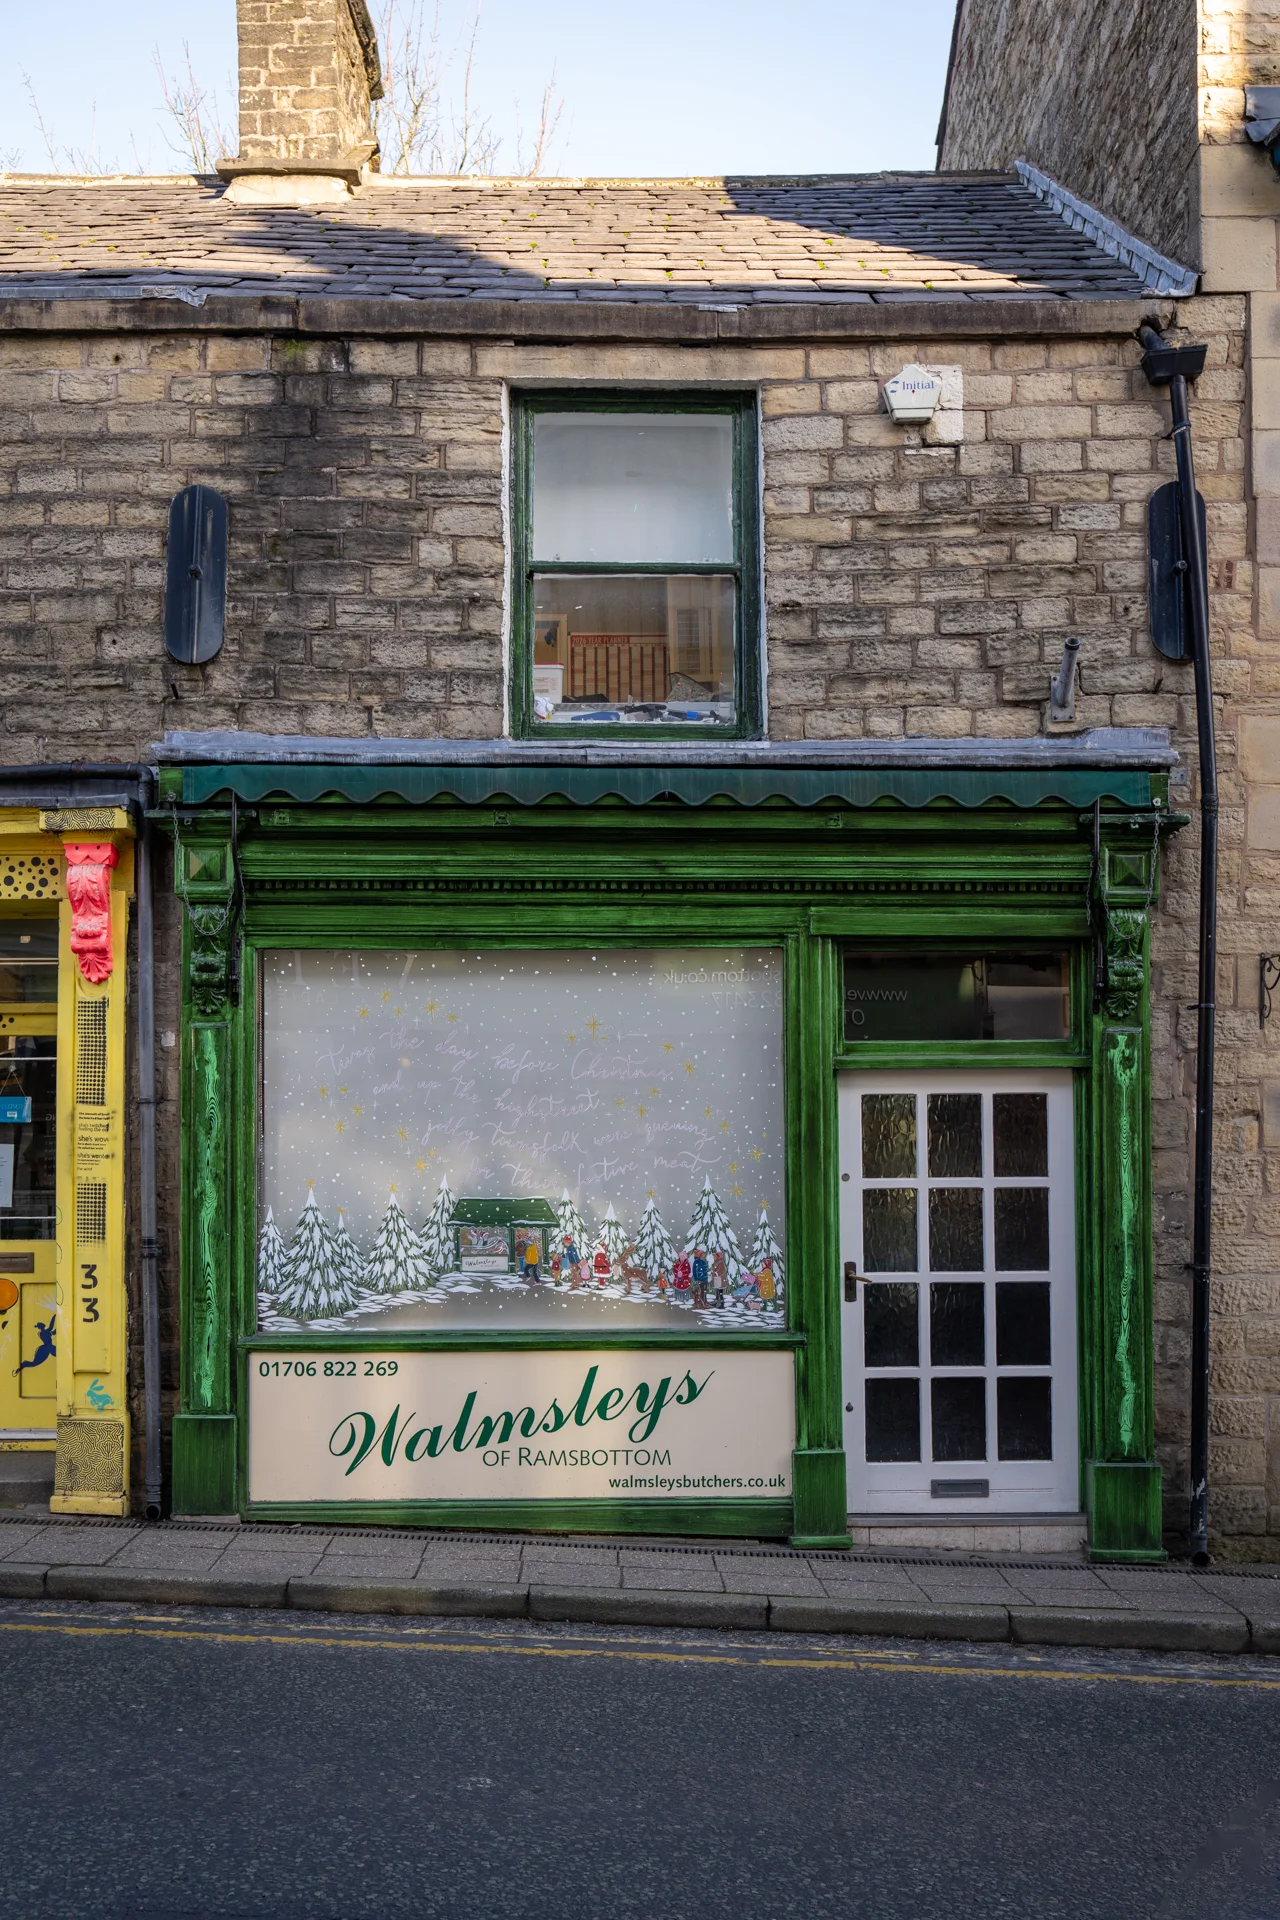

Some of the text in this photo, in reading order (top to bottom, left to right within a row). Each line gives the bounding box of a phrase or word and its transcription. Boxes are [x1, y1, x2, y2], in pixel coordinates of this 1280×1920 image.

[902, 380, 935, 390] Initial
[588, 636, 602, 644] YEAR
[603, 636, 629, 644] PLANNER
[435, 1029, 479, 1073] day
[491, 1043, 559, 1085] before
[571, 1048, 673, 1081] Christmas
[373, 1069, 403, 1095] and
[417, 1080, 441, 1105] up
[421, 1116, 480, 1156] jolly
[593, 1131, 633, 1147] were
[462, 1157, 495, 1185] for
[573, 1157, 639, 1200] festive
[653, 1151, 722, 1173] meat
[258, 1360, 399, 1377] 01706 822 269
[328, 1365, 716, 1477] Walmsleys
[483, 1450, 511, 1467] OF
[608, 1474, 786, 1492] walmsleysbutchers.co.uk
